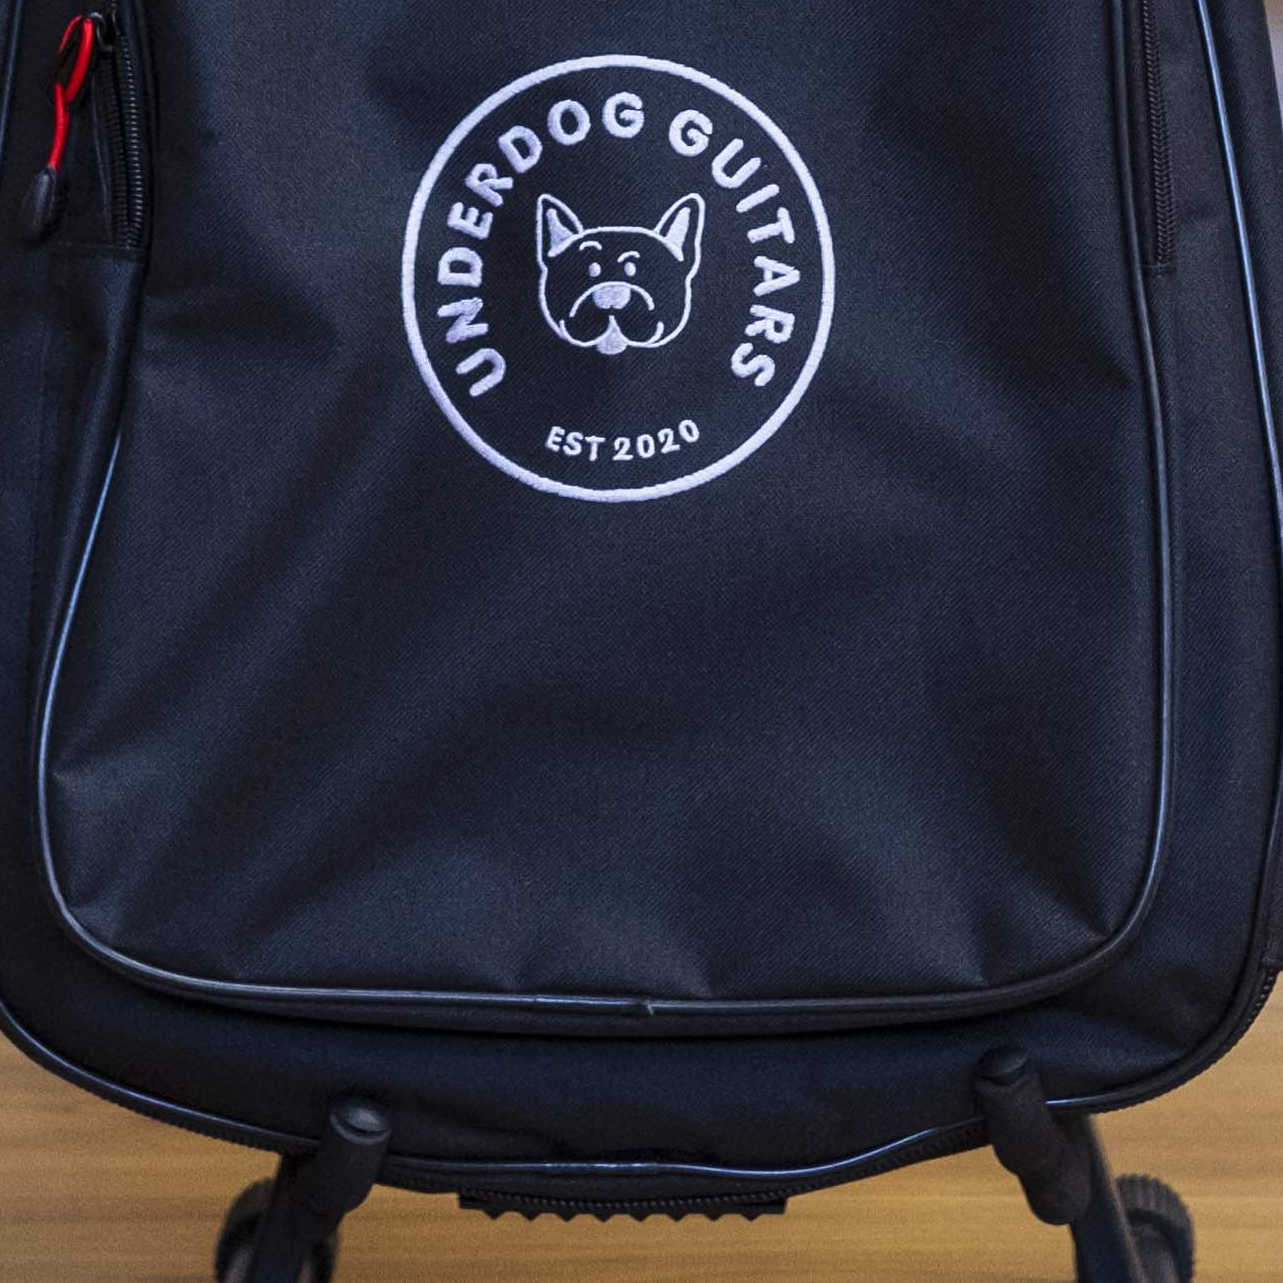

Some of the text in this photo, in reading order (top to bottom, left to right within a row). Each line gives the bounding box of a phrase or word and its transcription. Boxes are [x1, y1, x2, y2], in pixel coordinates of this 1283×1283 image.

[436, 91, 802, 397] UNDERDOG GUITARS
[545, 419, 700, 462] EST 2020
